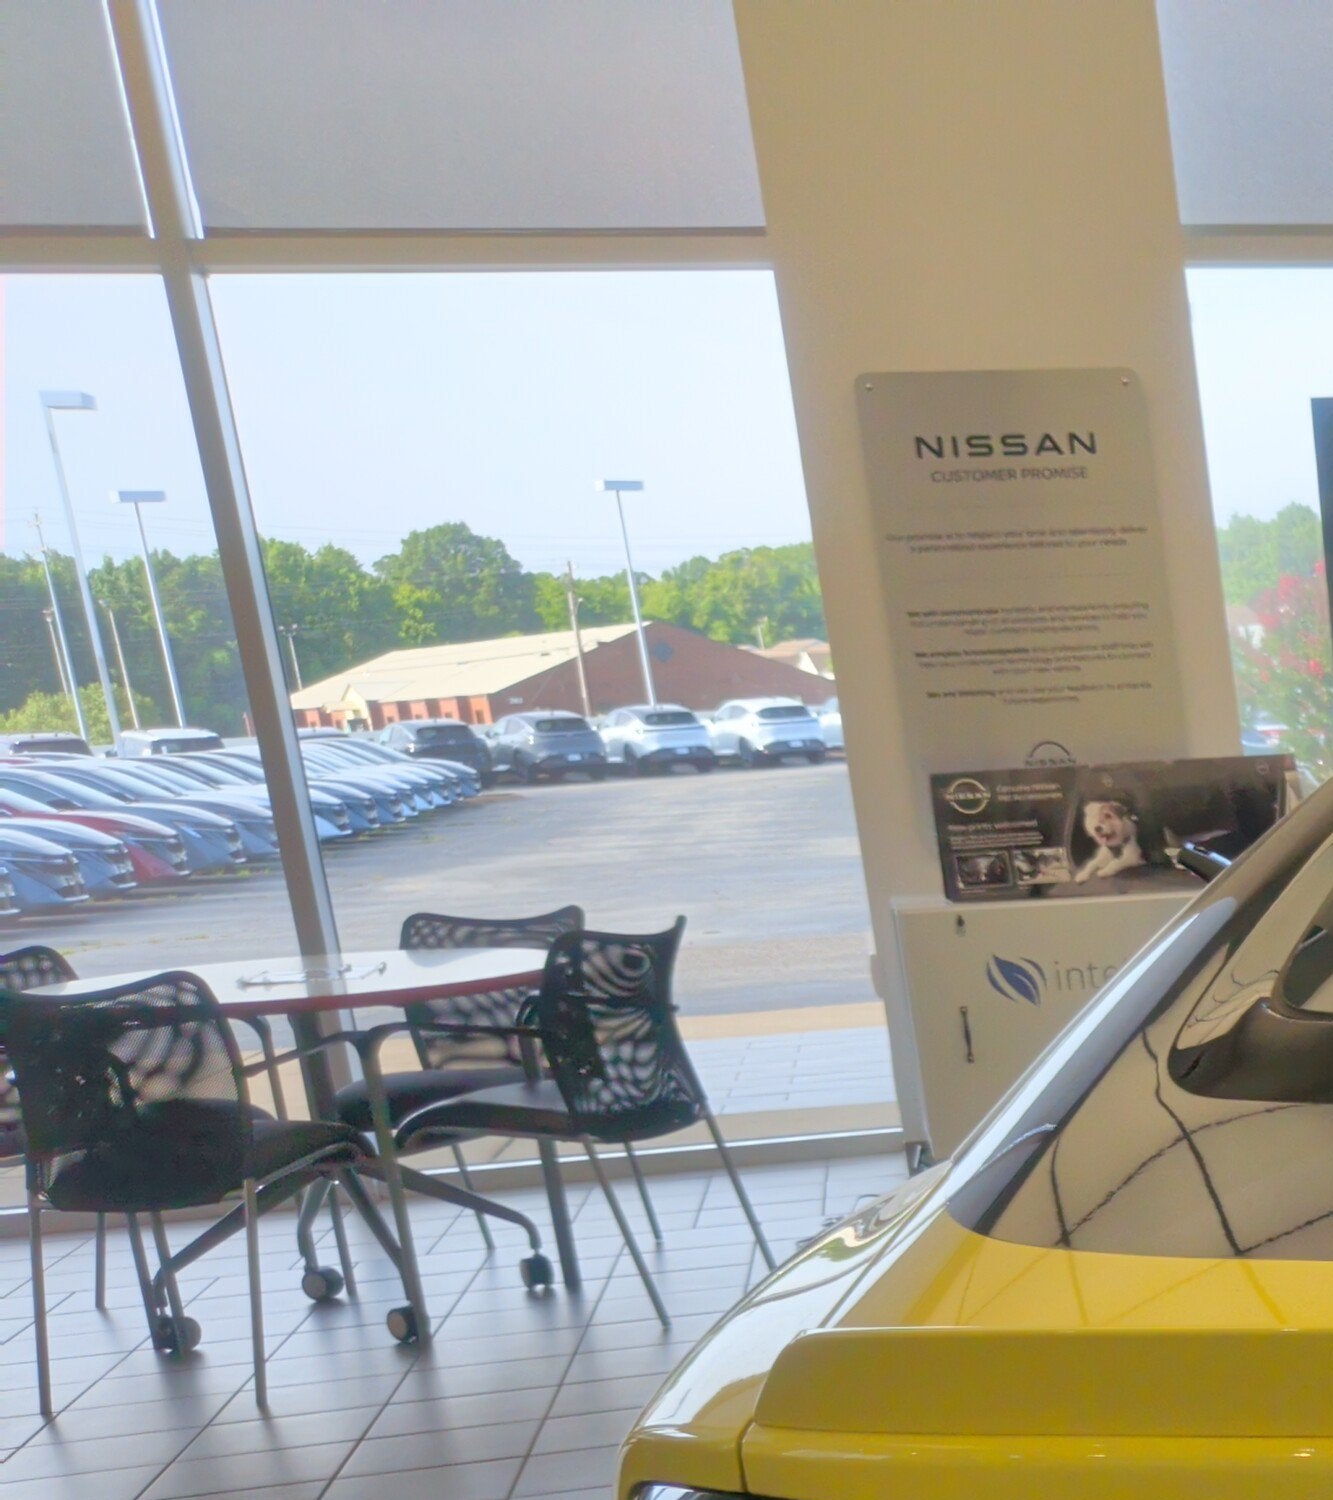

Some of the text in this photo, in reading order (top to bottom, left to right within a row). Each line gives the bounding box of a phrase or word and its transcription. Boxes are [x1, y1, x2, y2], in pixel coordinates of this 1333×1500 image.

[914, 431, 1098, 459] NISSAN
[931, 466, 1088, 484] CUSTOMER PROMISE
